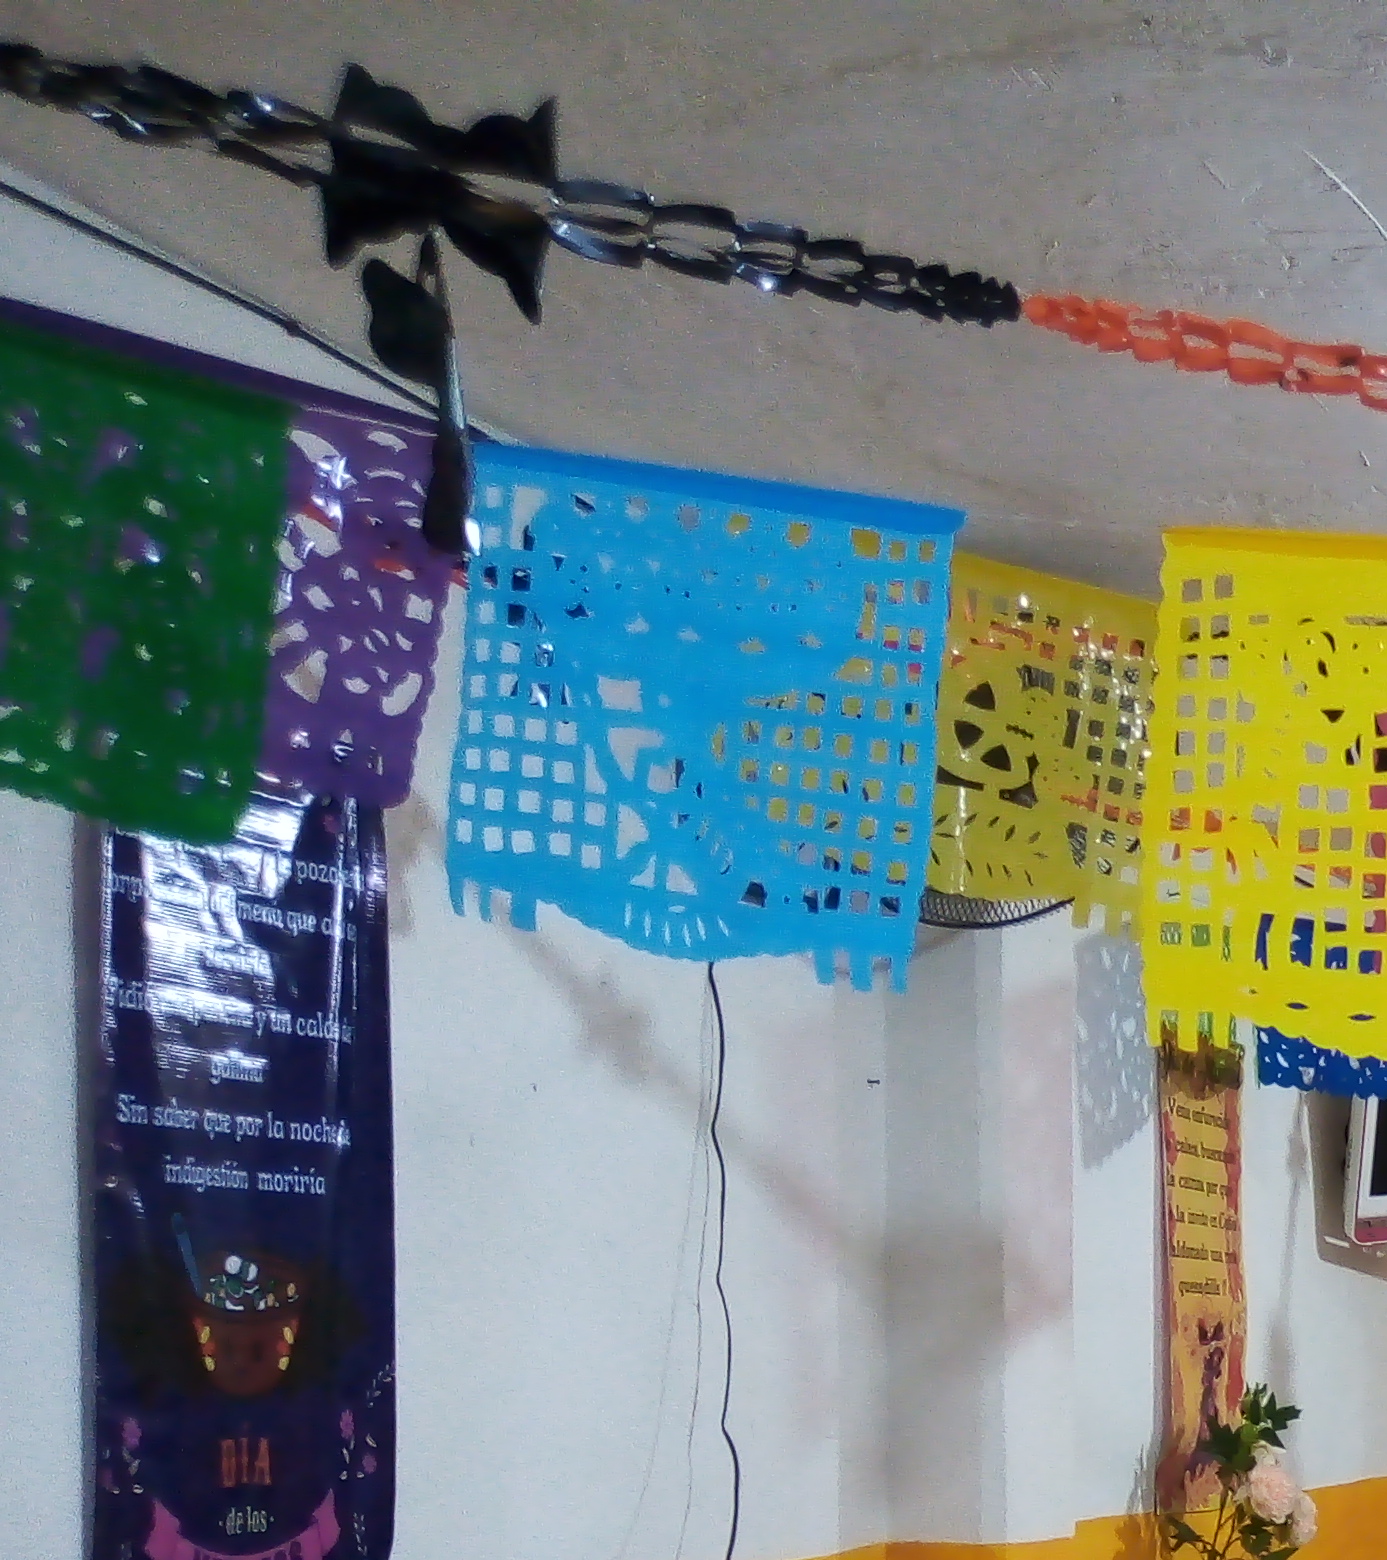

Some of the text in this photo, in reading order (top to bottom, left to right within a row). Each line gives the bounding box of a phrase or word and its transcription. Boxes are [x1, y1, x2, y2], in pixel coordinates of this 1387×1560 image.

[235, 1114, 264, 1142] por
[266, 1111, 284, 1139] la
[256, 1165, 326, 1195] moriría
[225, 1505, 268, 1536] de los
